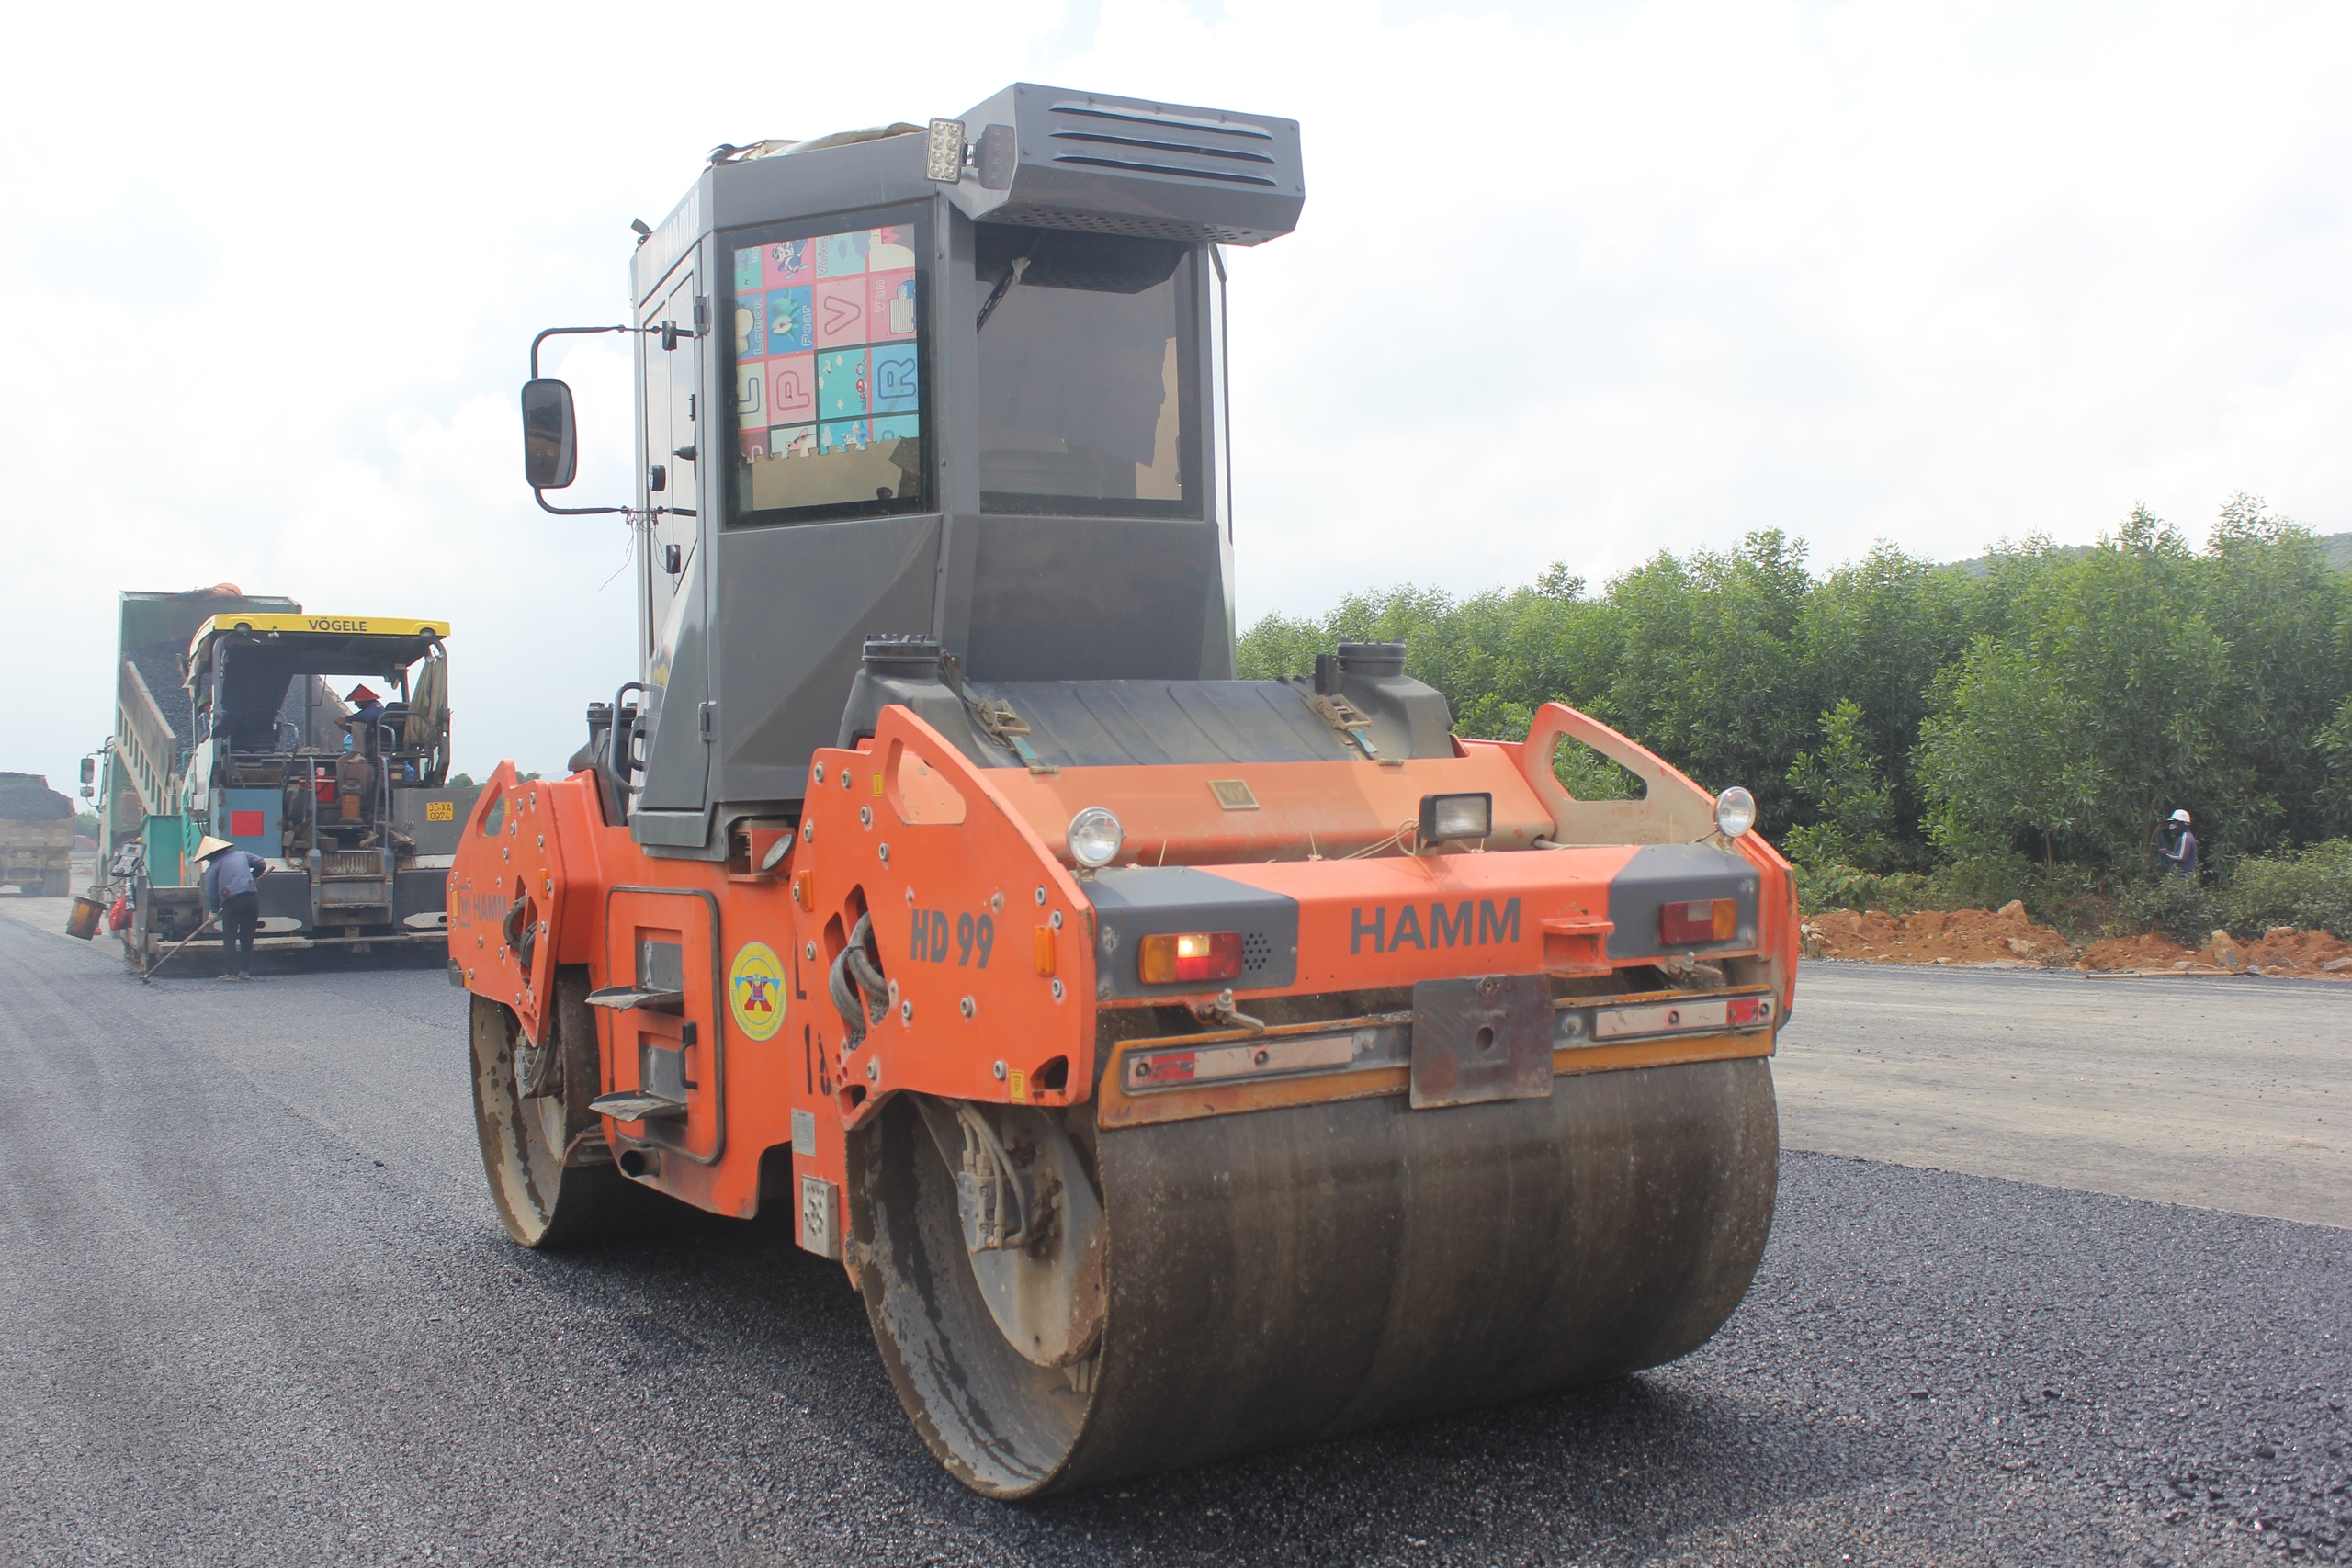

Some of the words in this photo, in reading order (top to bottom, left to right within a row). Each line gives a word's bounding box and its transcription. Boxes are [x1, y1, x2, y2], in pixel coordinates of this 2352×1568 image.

[874, 279, 886, 314] Van
[752, 298, 763, 355] Lemon
[801, 304, 813, 347] Pear
[775, 369, 811, 411] P
[877, 357, 917, 399] R
[308, 616, 368, 632] VÖGELE
[428, 803, 452, 812] 35-XA
[430, 812, 450, 820] 0974
[473, 892, 508, 923] HAMM
[1350, 897, 1521, 955] HAMM
[910, 908, 949, 964] HD
[956, 911, 995, 969] 99
